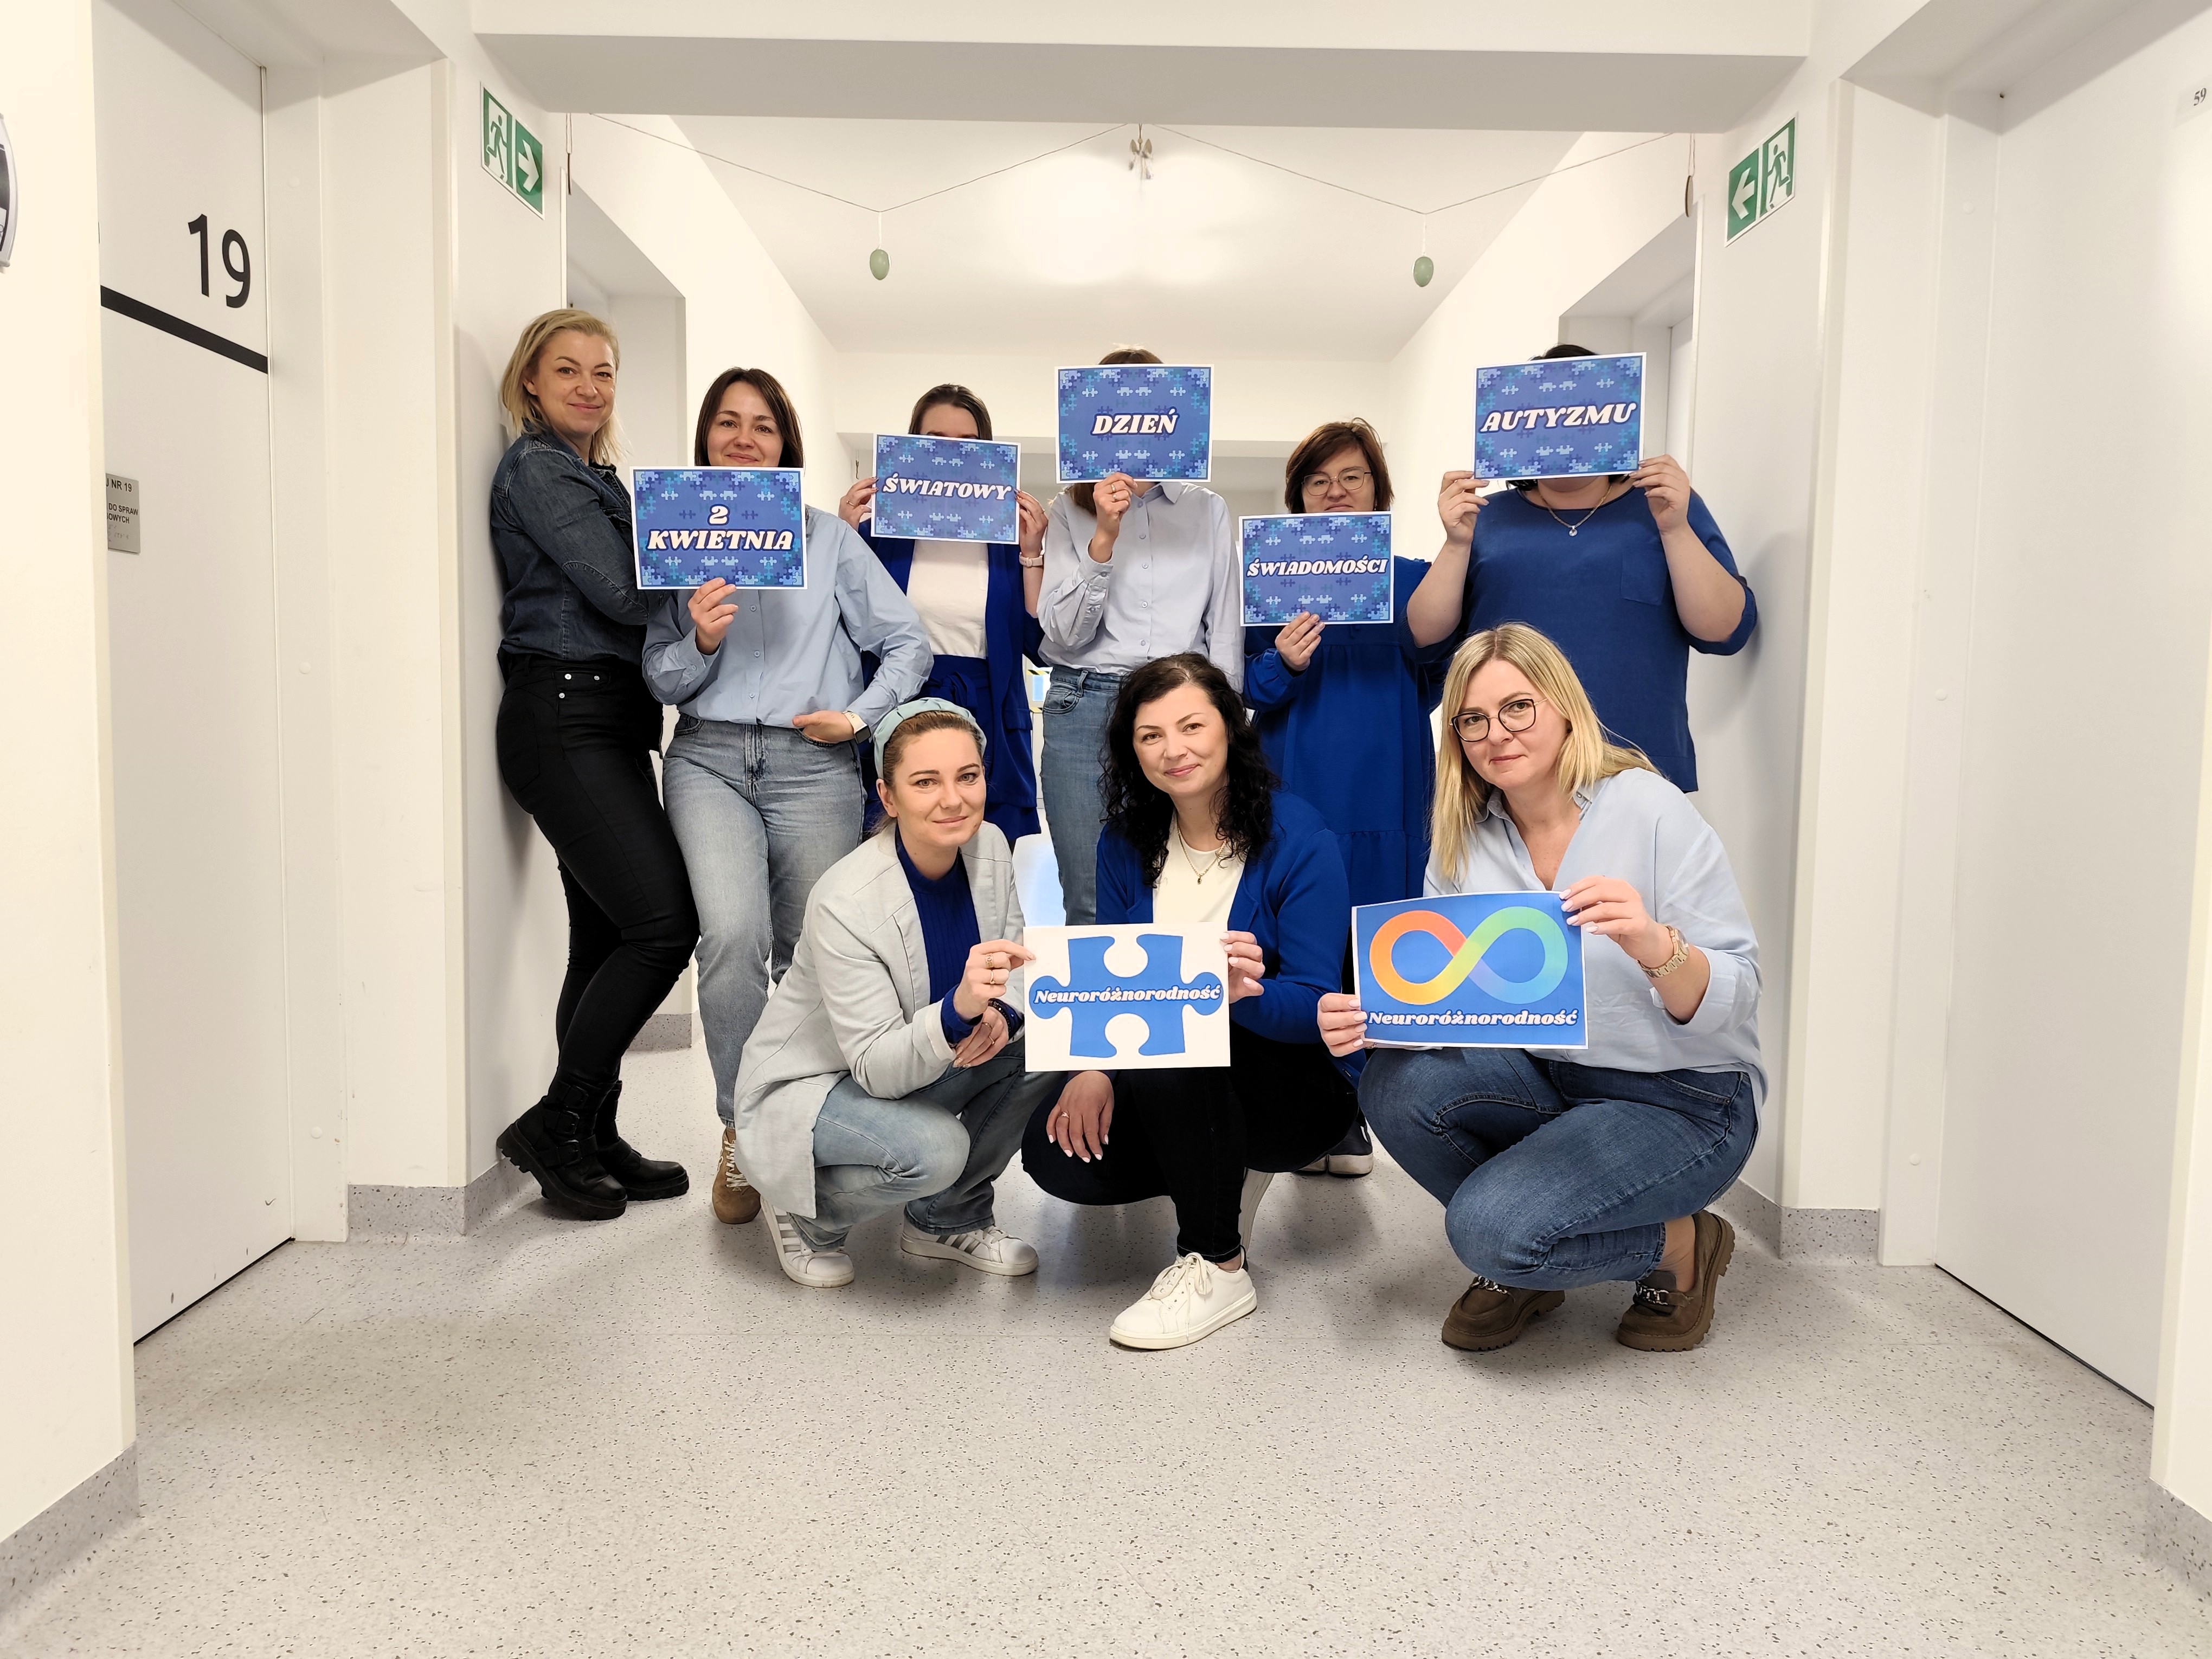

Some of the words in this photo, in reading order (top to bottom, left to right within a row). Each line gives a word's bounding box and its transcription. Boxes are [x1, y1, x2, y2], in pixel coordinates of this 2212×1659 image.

[2193, 87, 2207, 106] 59
[188, 213, 251, 308] 19
[1091, 408, 1179, 434] DZIEŃ
[1480, 402, 1637, 432] AUTYZMU
[111, 479, 123, 491] NR
[124, 482, 132, 492] 19
[882, 473, 1012, 500] ŚWIATOWY
[108, 503, 117, 511] DO
[118, 505, 139, 516] SPRAW
[709, 505, 729, 525] 2
[647, 530, 794, 550] KWIETNIA
[1246, 555, 1389, 577] ŚWIADOMOŚCI
[1033, 985, 1221, 1004] Neuroróżnorodność
[1367, 1009, 1579, 1026] Neuroróżnorodność
